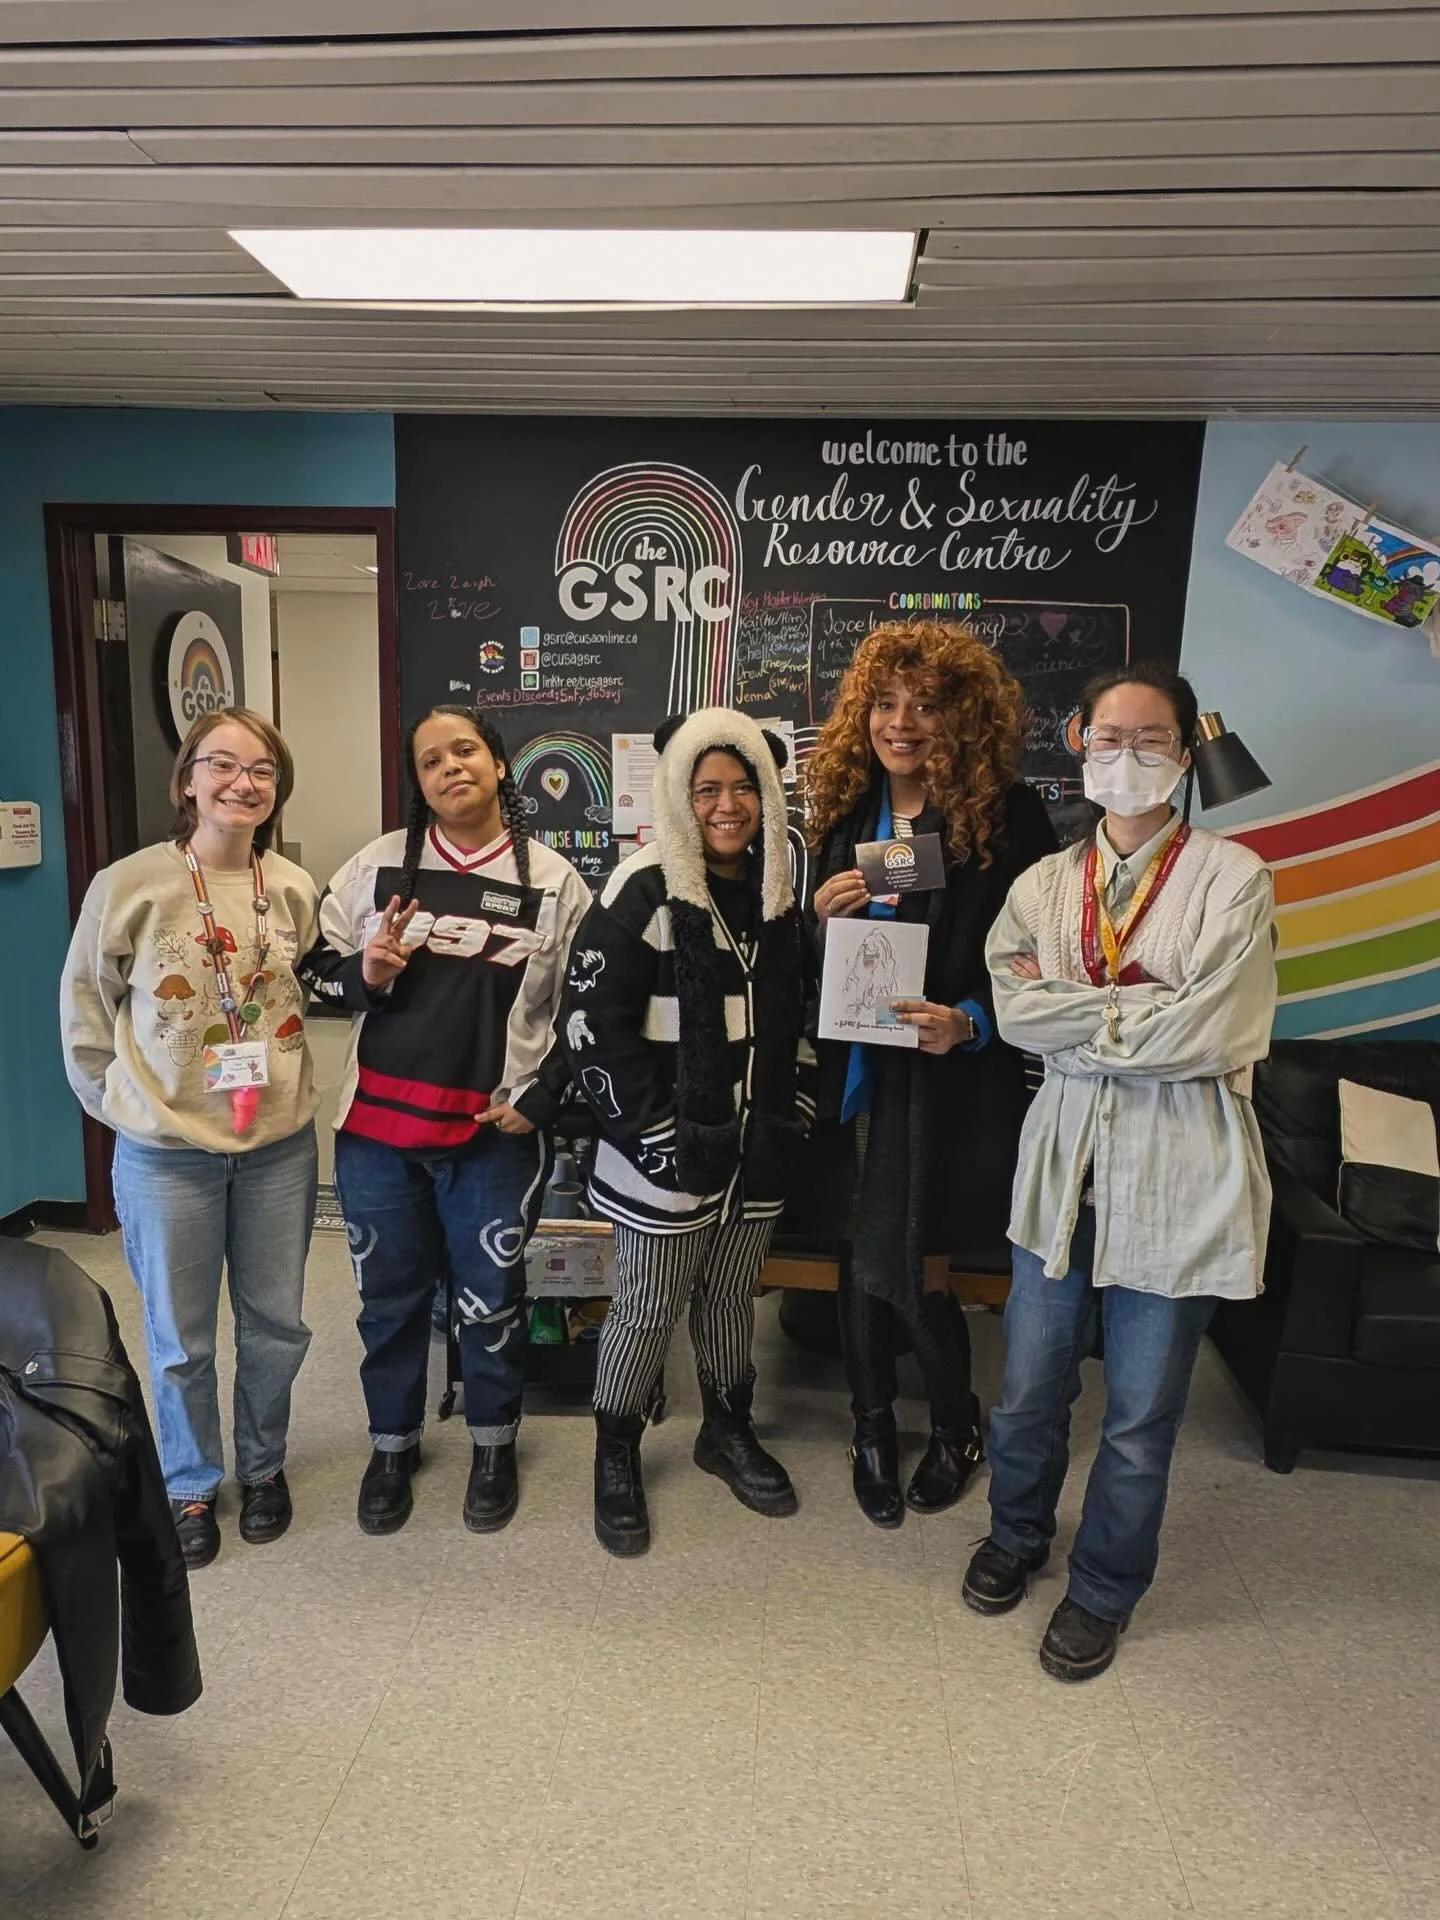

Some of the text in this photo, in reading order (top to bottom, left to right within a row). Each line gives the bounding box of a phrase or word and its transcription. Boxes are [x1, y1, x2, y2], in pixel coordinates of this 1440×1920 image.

[822, 430, 1028, 467] welcome to the
[736, 464, 1158, 552] Gender & Sexuality
[635, 536, 667, 561] the
[764, 523, 1071, 571] Resource Centre
[559, 565, 732, 622] GSRC
[889, 592, 982, 610] COORDINATORS
[541, 652, 602, 668] @cusagsrc
[535, 829, 609, 849] HOUSE RULES
